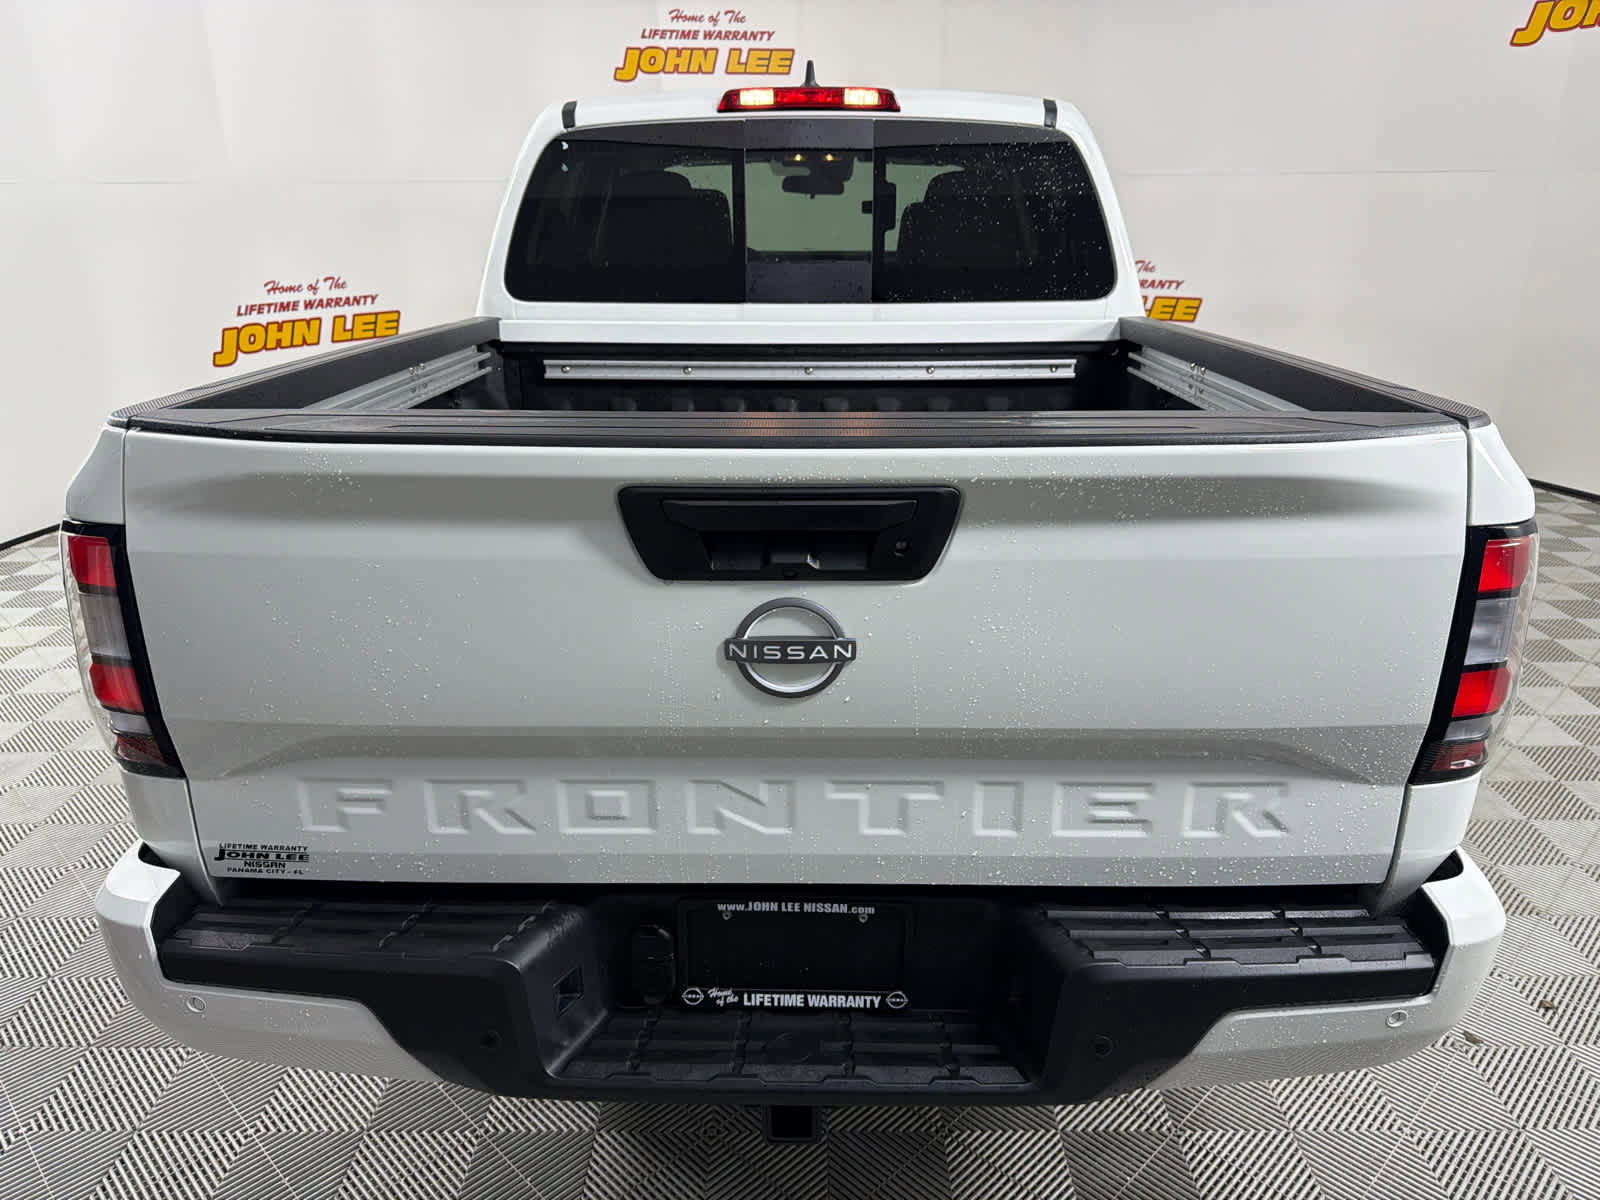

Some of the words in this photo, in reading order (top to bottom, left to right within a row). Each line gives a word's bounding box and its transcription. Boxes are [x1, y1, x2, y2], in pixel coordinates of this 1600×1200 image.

[668, 8, 705, 24] Home
[707, 11, 720, 27] of
[724, 9, 746, 24] The
[640, 28, 700, 41] LIFETIME
[703, 29, 775, 42] WARRANTY
[614, 46, 718, 82] JOHN
[725, 48, 795, 75] LEE
[263, 280, 303, 295] Home
[306, 279, 320, 295] of
[323, 276, 347, 290] The
[236, 300, 301, 317] LIFETIME
[303, 294, 379, 311] WARRANTY
[213, 317, 322, 367] JOHN
[331, 310, 400, 343] LEE
[729, 643, 852, 660] NISSAN
[297, 776, 1293, 840] FRONTIER
[214, 849, 270, 861] JOHN
[275, 852, 309, 862] LEE
[260, 844, 308, 852] WARRANTY
[243, 861, 286, 869] NISSAN
[781, 902, 801, 912] LEE
[803, 903, 875, 914] NISSAN.com
[743, 992, 805, 1007] LIFETIME
[807, 994, 881, 1009] WARRANTY
